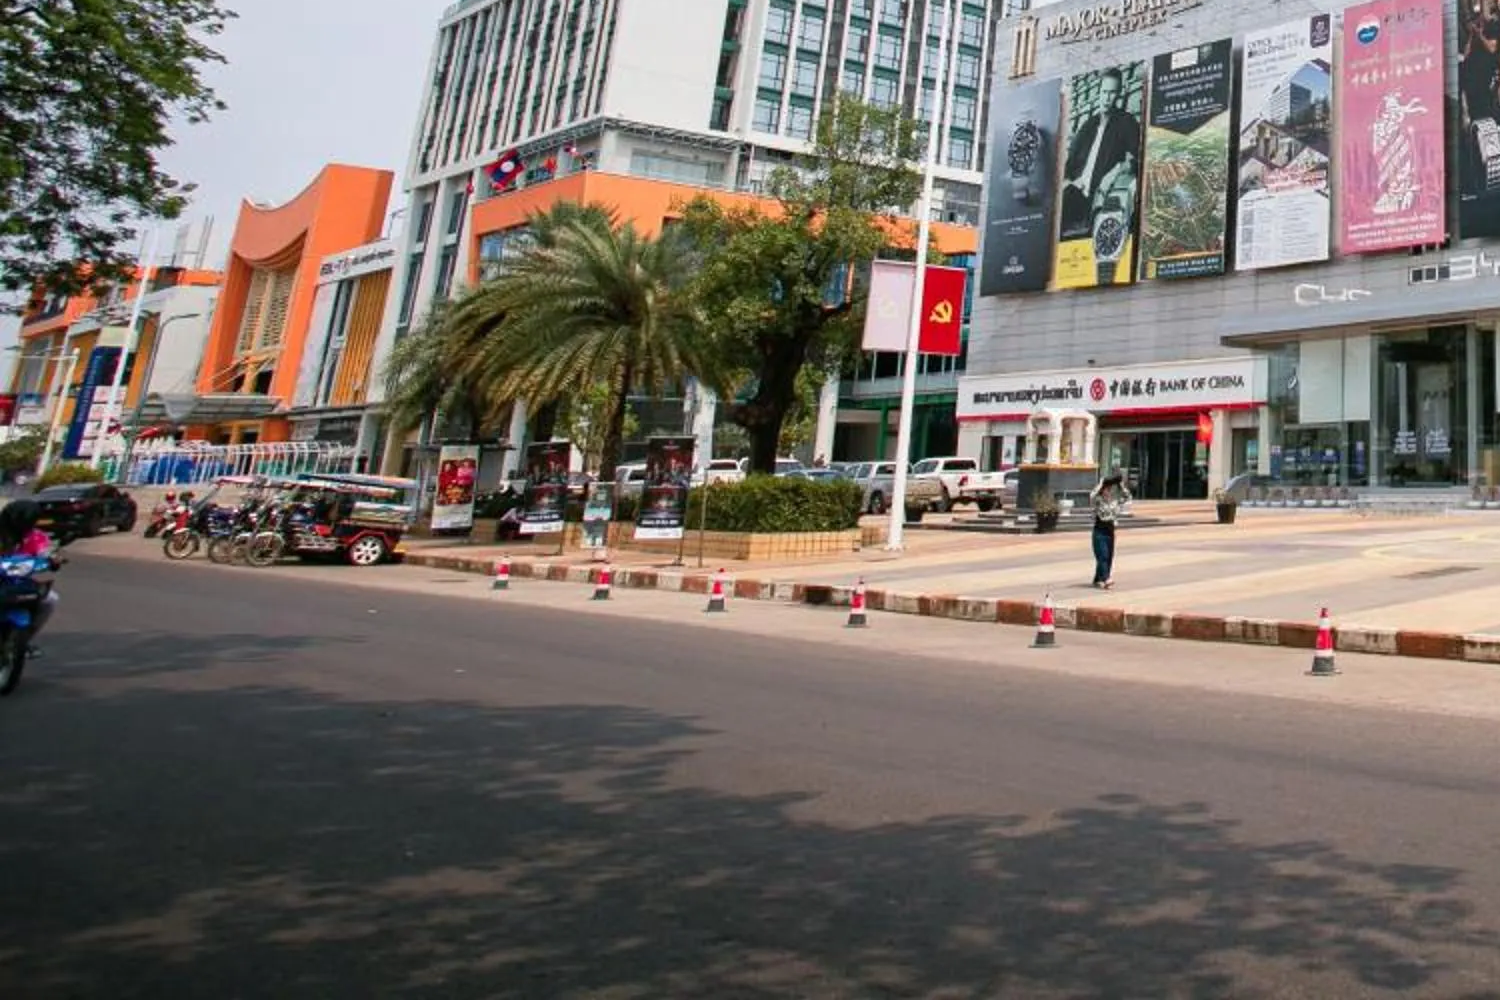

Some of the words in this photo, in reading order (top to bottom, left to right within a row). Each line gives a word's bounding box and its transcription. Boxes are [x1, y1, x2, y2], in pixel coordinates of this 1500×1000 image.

[1046, 5, 1107, 41] MAJOR
[1159, 378, 1189, 393] BANK
[1191, 376, 1207, 390] OF
[1208, 374, 1245, 389] CHINA
